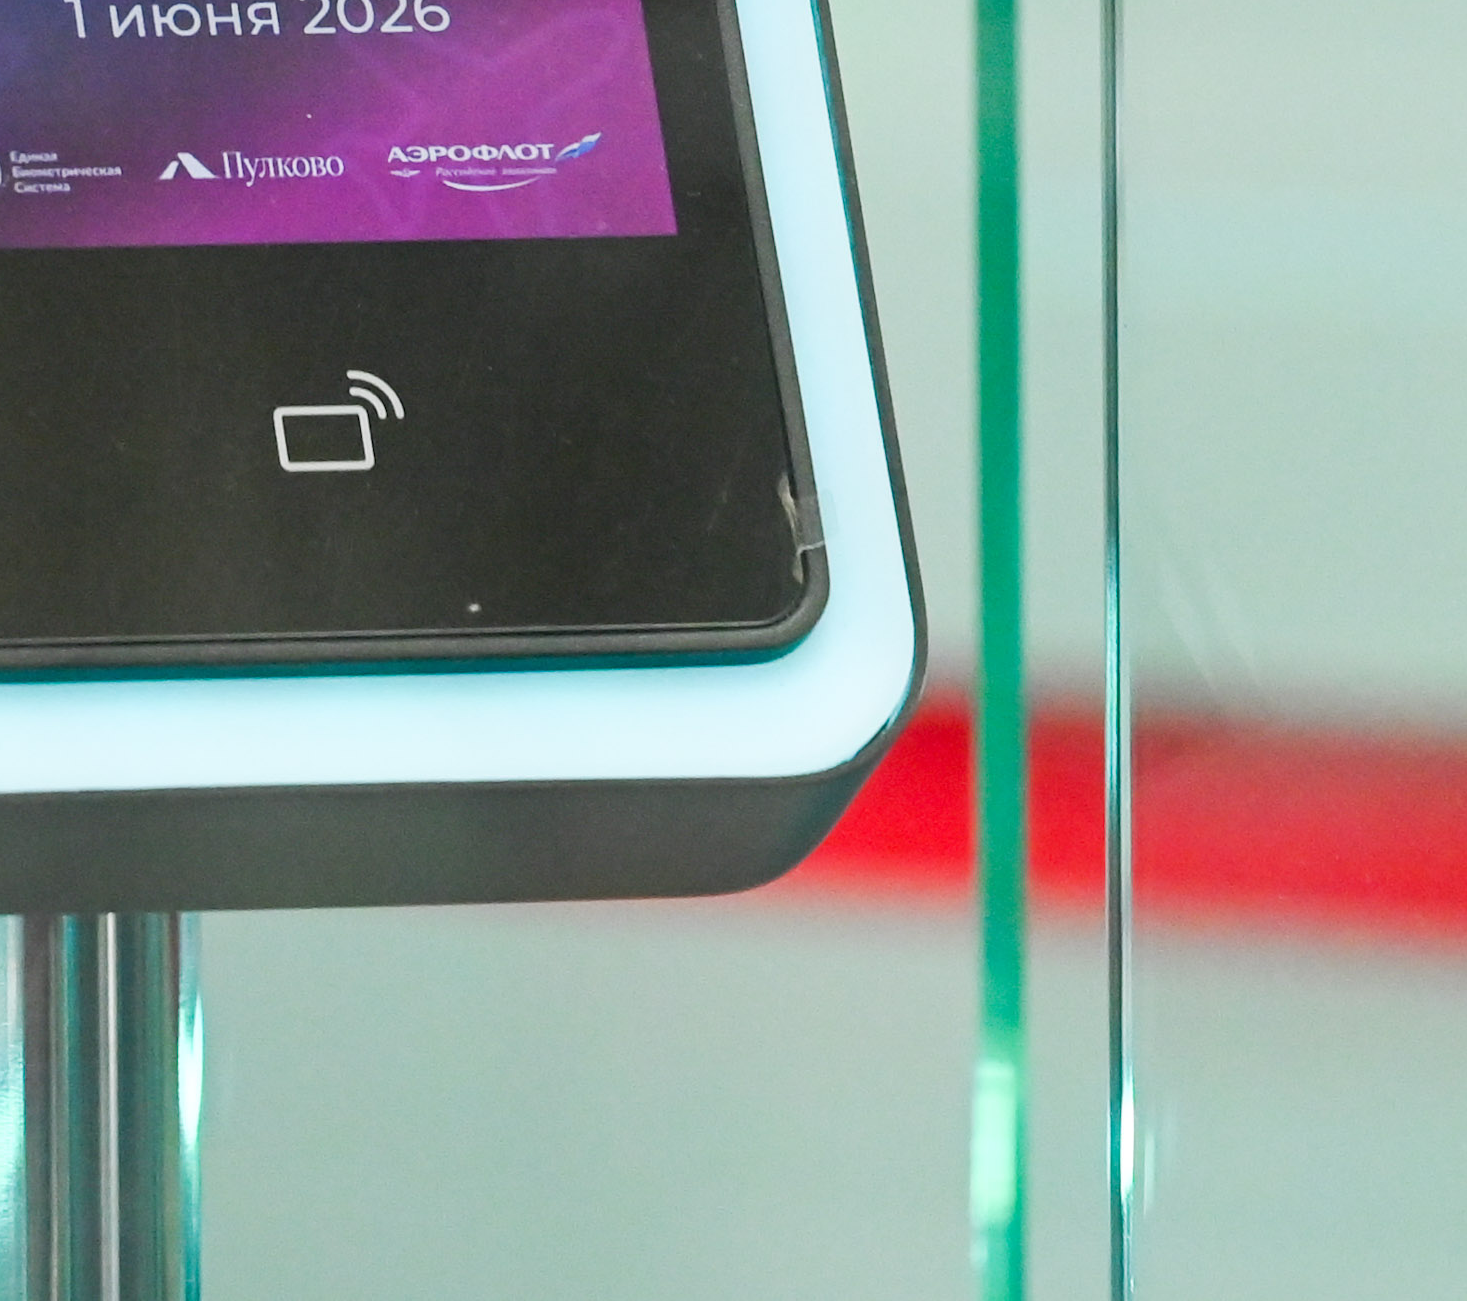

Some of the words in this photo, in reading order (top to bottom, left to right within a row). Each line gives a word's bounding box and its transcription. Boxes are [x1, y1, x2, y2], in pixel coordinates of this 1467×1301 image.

[109, 1, 281, 38] июня
[221, 151, 345, 187] Пулково
[387, 143, 555, 163] АЭРОФЛОТ
